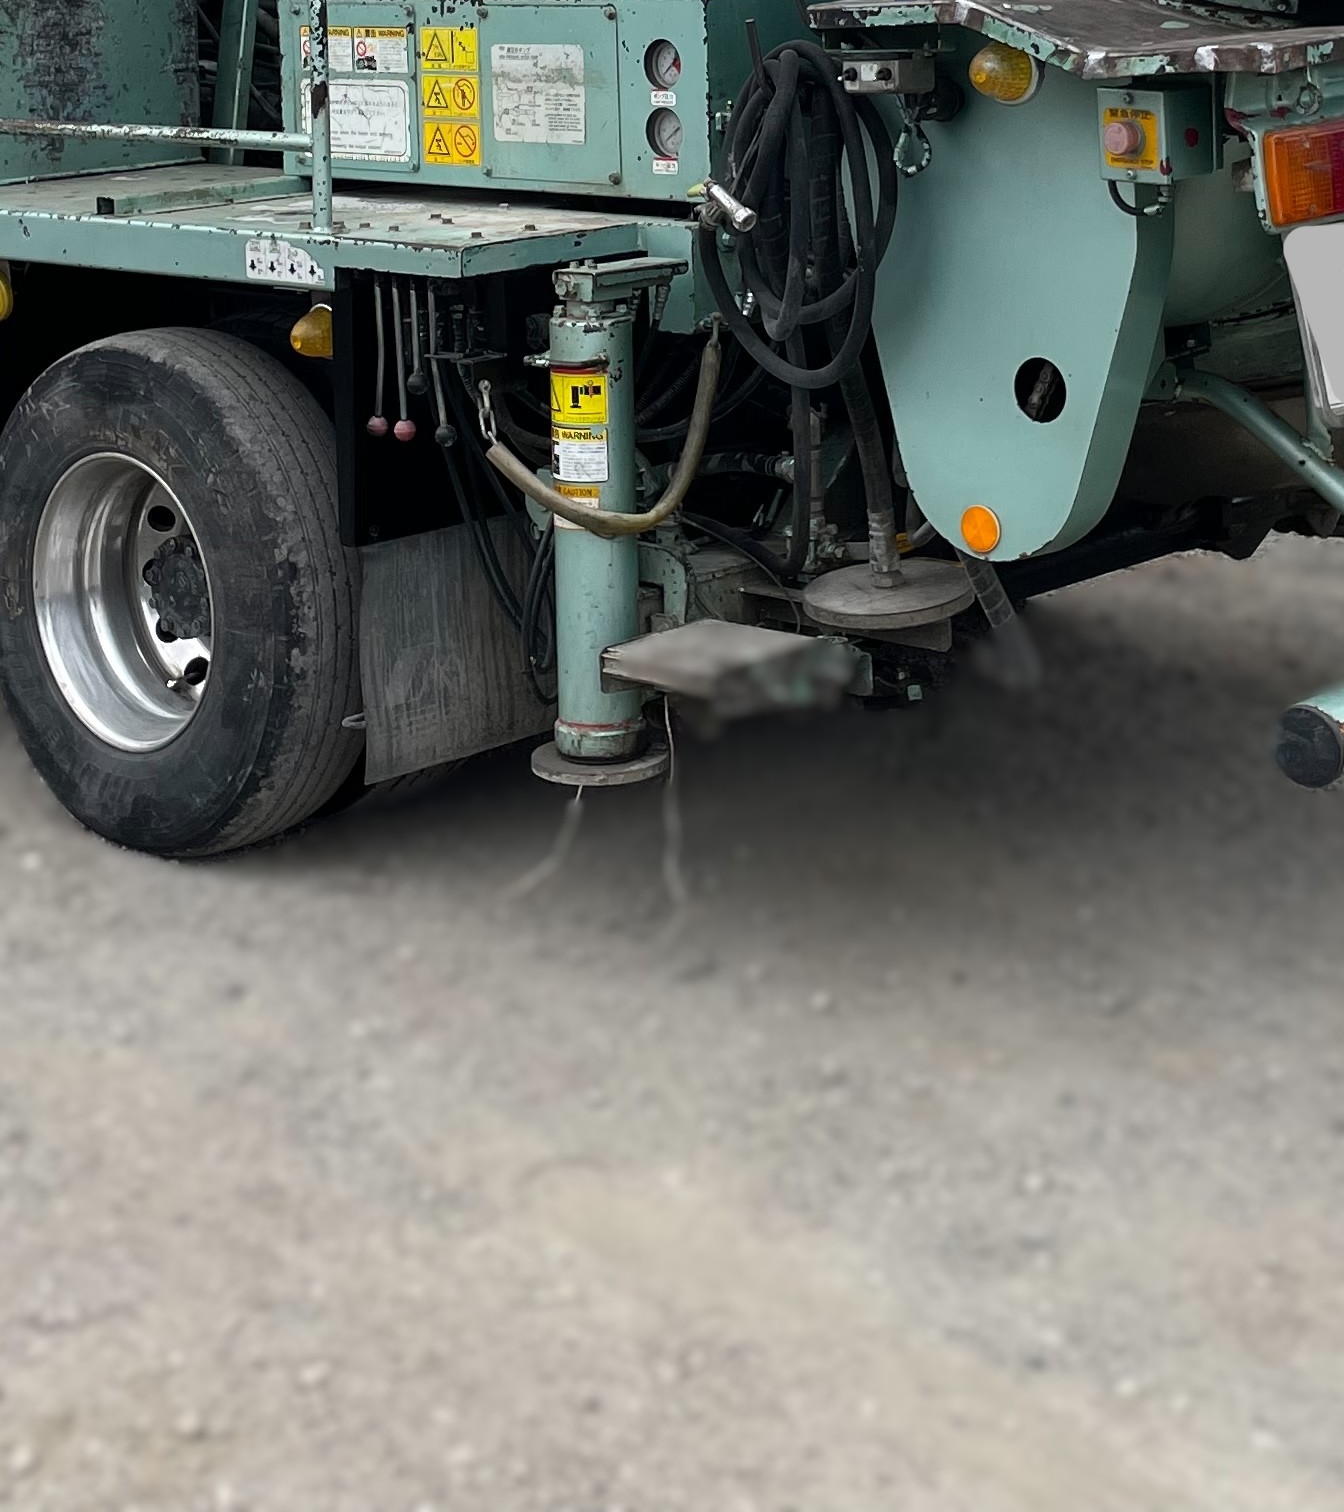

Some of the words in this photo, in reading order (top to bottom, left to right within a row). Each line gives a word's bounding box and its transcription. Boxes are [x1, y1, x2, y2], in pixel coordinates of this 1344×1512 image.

[378, 30, 405, 38] WARNING
[561, 431, 604, 440] WARNIG
[563, 487, 593, 497] CAUTION
